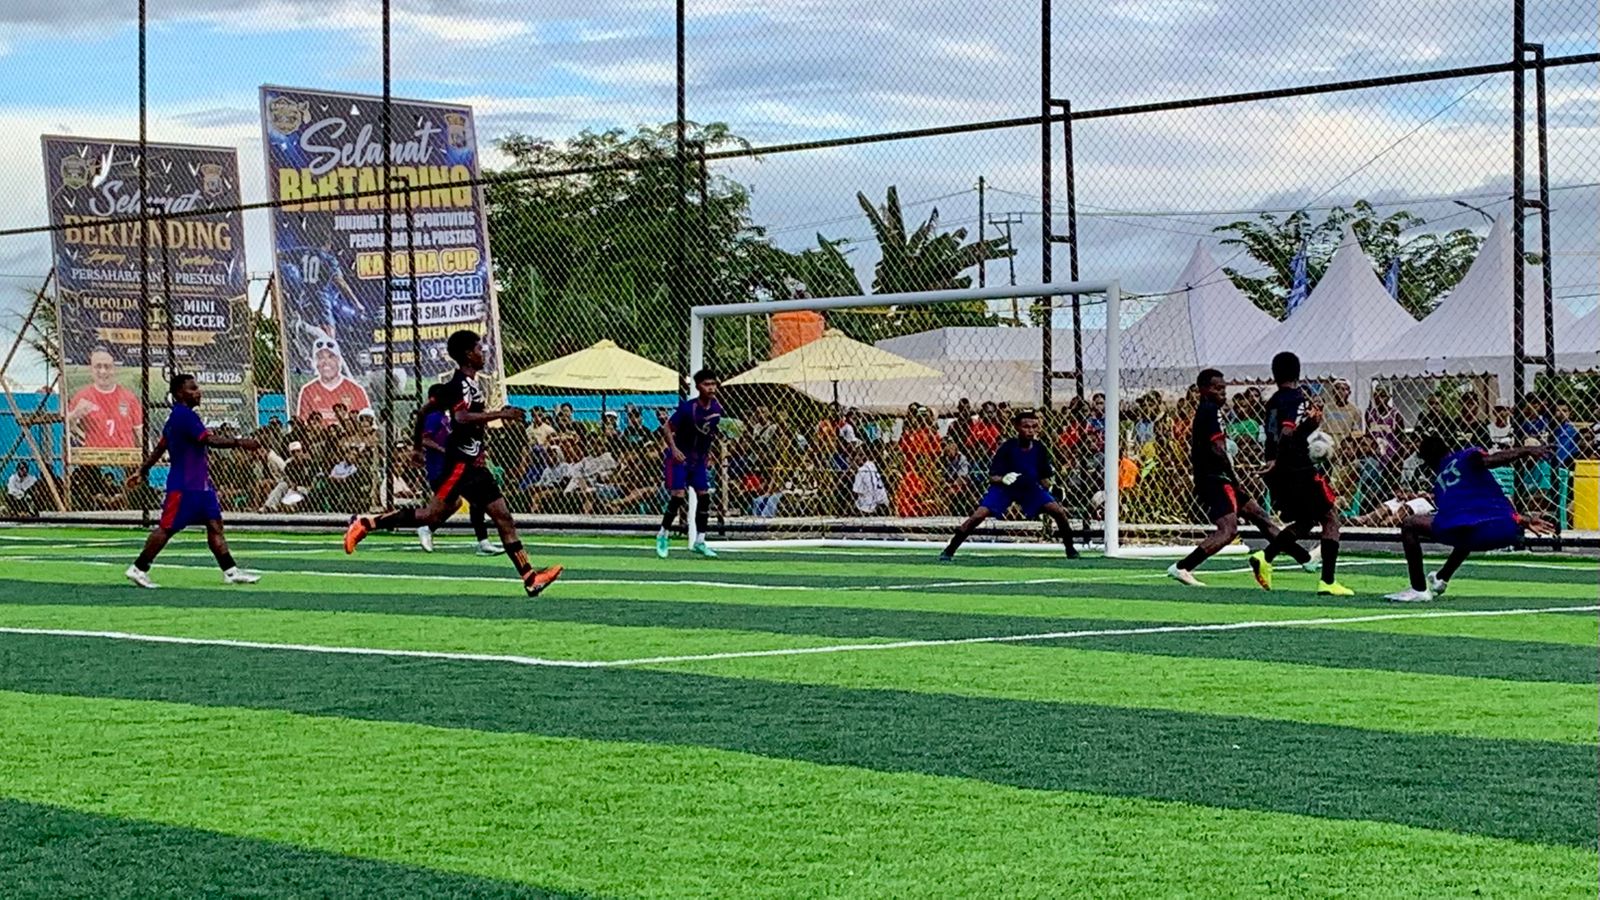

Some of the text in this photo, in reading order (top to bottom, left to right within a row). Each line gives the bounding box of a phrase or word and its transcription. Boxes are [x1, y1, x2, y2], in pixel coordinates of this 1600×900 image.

[441, 248, 479, 275] CUP
[421, 276, 483, 299] SOCCER
[183, 299, 215, 314] MINI
[425, 306, 447, 320] SMA
[100, 311, 124, 323] CUP
[174, 314, 226, 328] SOCCER
[217, 372, 242, 384] 2026
[106, 419, 115, 437] 7
